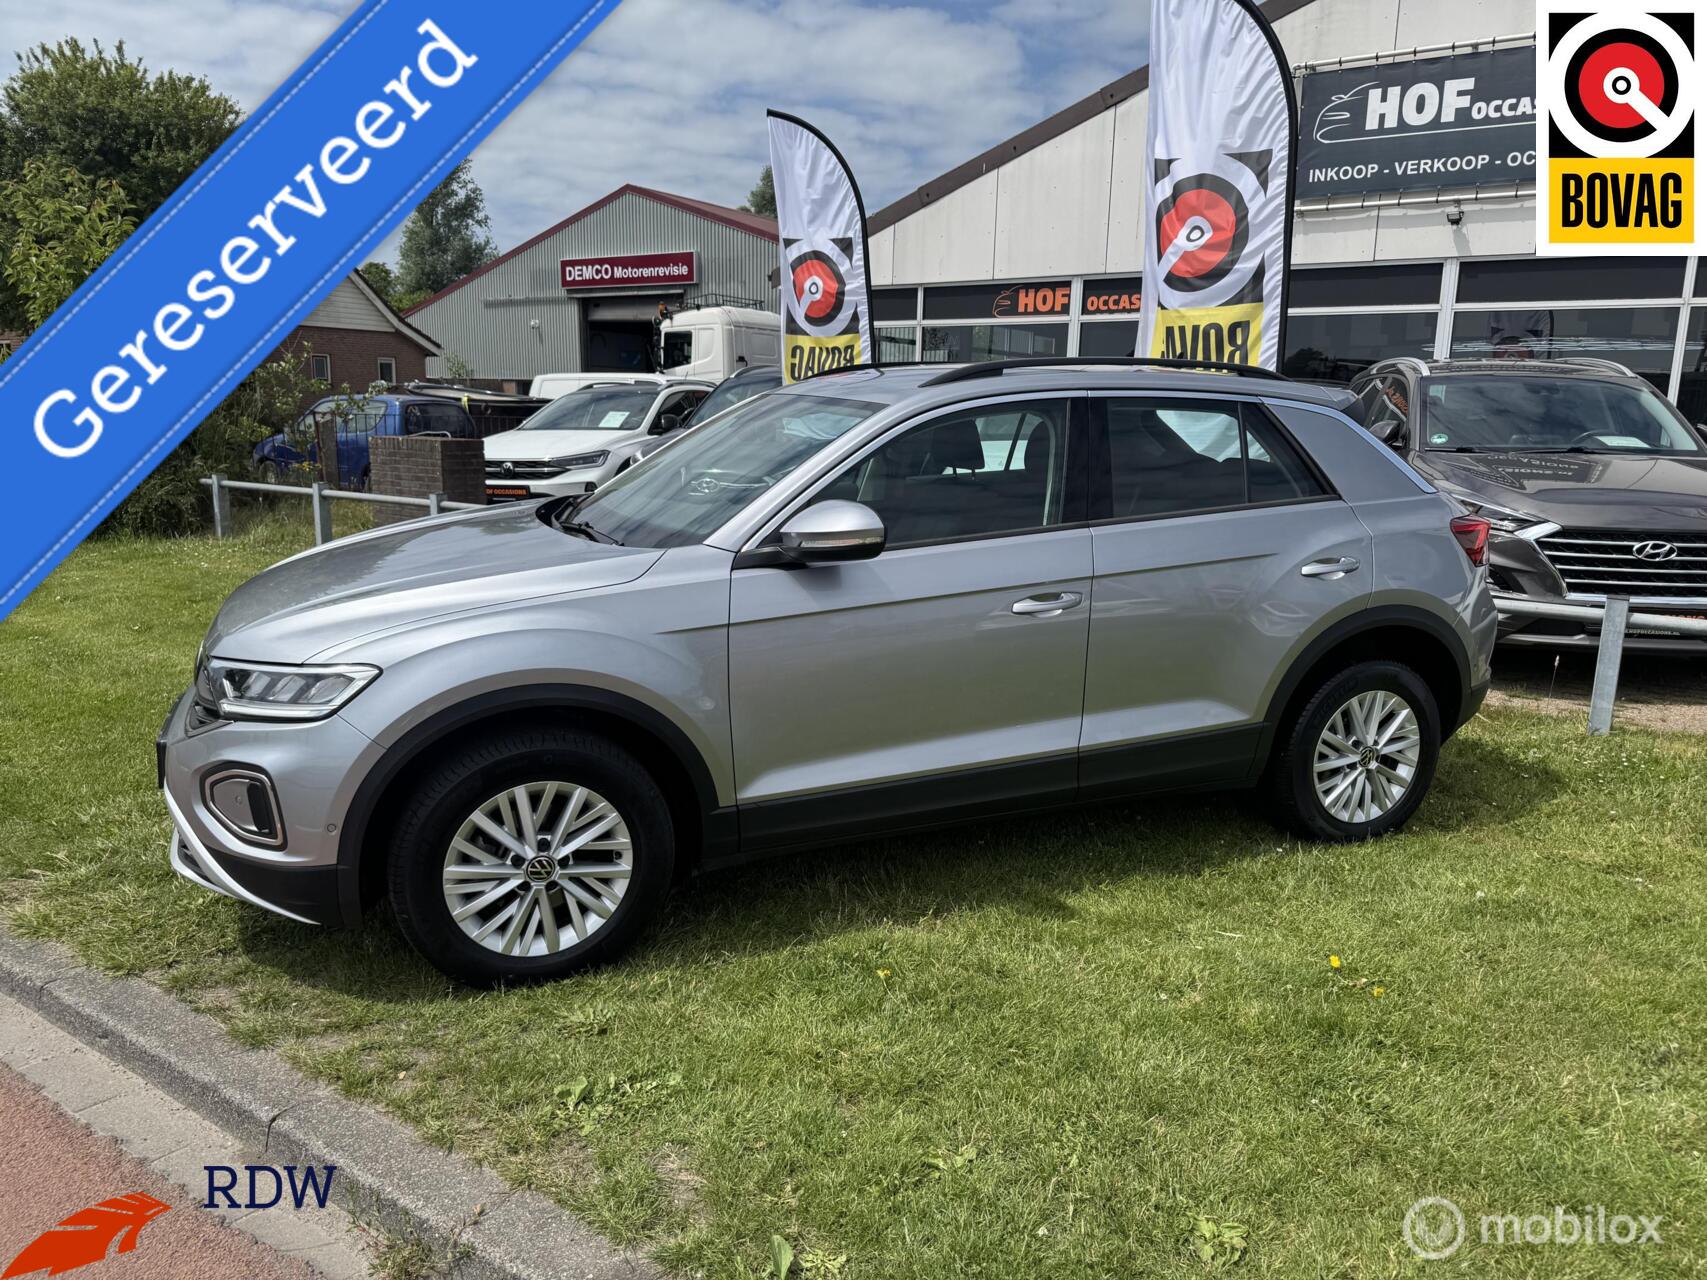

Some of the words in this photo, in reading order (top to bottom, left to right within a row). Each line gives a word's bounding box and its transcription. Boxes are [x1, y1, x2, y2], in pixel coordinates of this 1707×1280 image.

[1365, 77, 1475, 131] HOF
[1308, 163, 1379, 183] INKOOP
[1394, 154, 1490, 176] VERKOOP
[565, 264, 612, 281] DEMCO
[614, 262, 689, 279] Motorenrevisie
[1018, 287, 1071, 313] HOF
[1087, 293, 1141, 311] OCCAS
